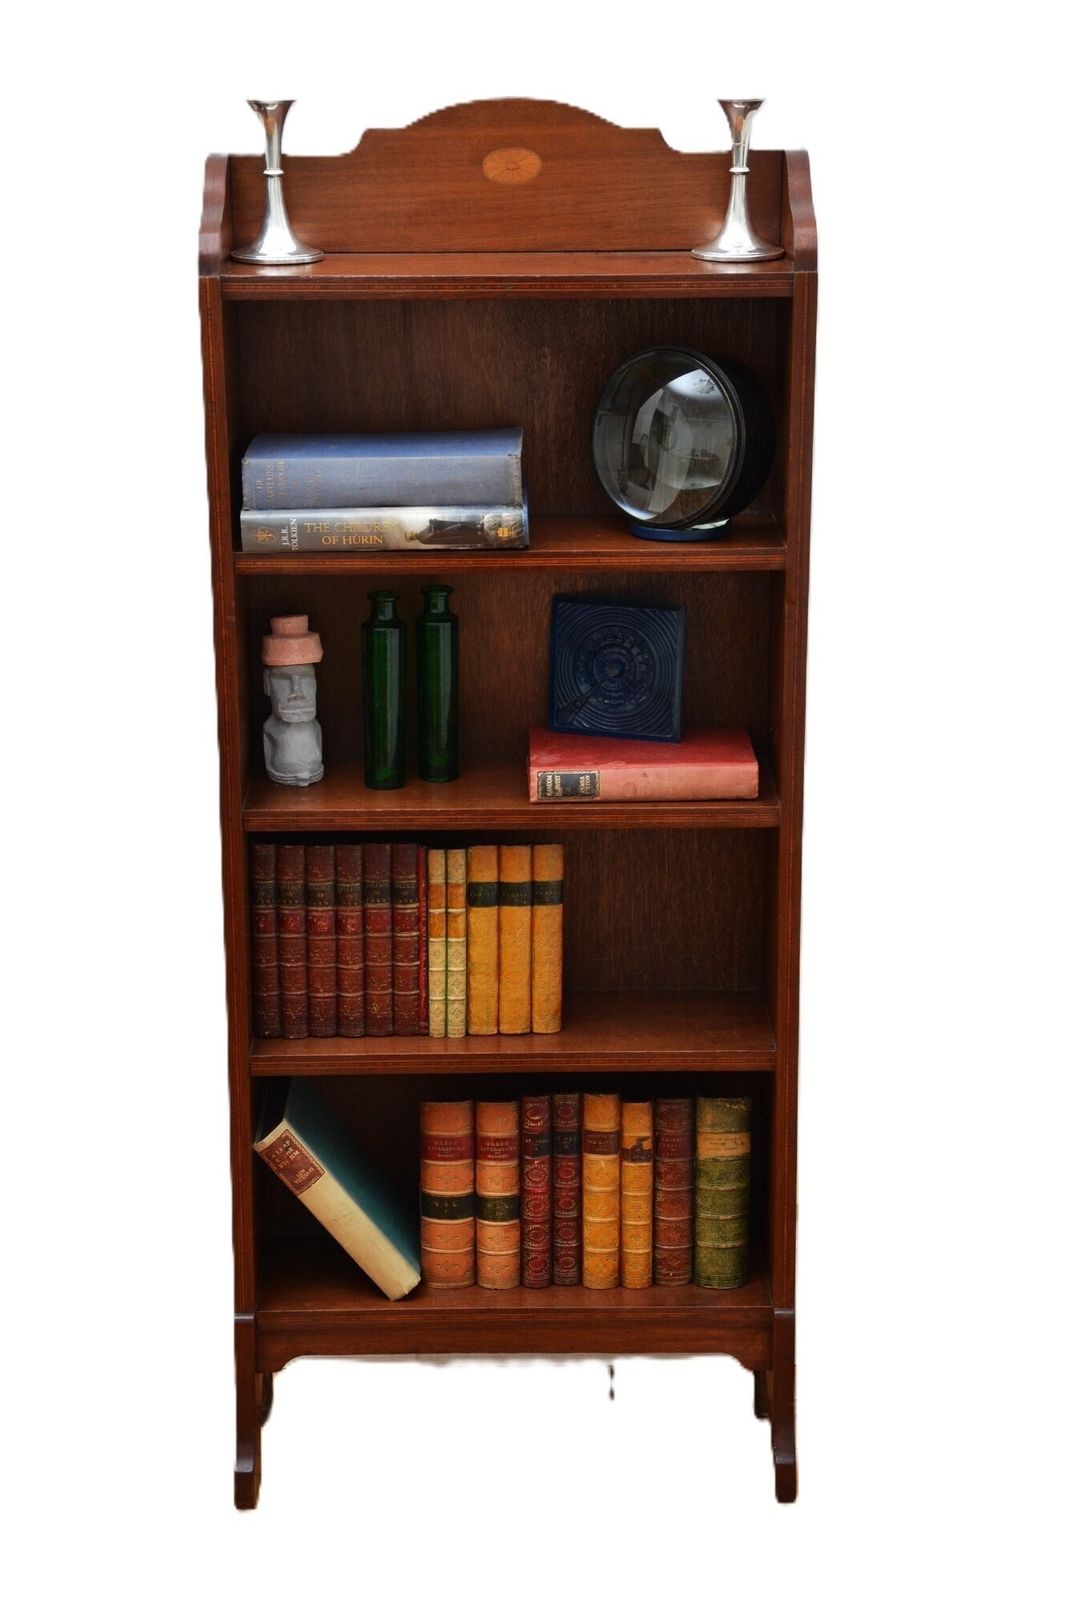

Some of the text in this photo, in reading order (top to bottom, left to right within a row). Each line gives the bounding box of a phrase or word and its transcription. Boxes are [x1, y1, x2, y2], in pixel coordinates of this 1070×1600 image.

[304, 522, 331, 533] THE
[290, 518, 299, 551] TOLKIEN
[321, 535, 383, 545] OF HURIN
